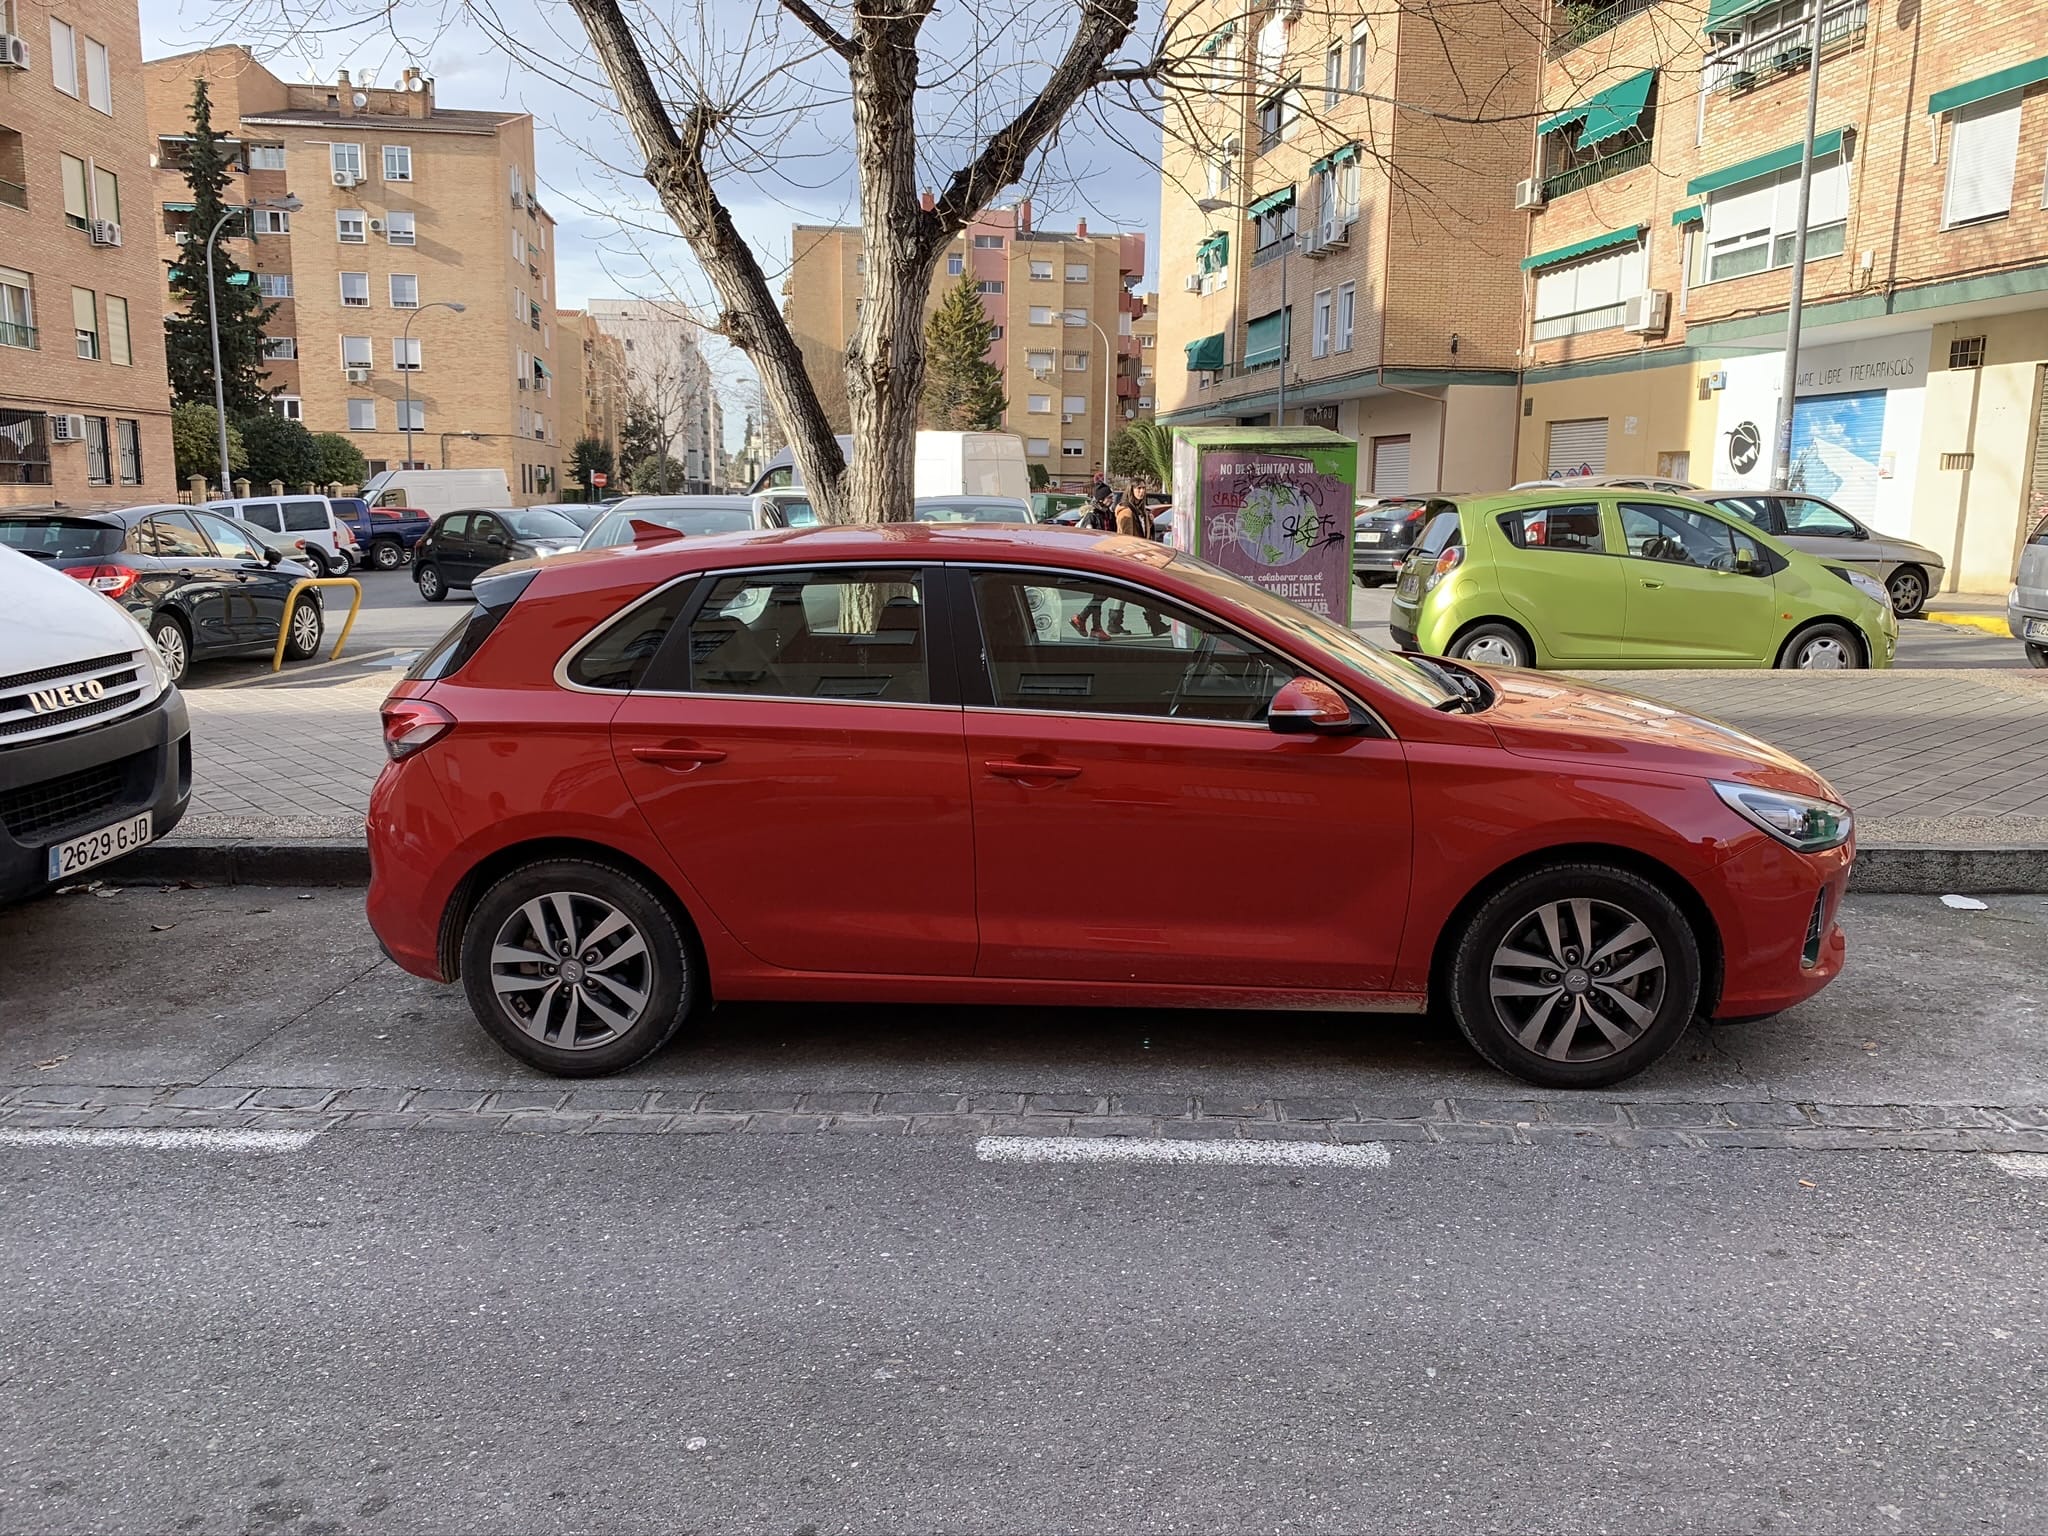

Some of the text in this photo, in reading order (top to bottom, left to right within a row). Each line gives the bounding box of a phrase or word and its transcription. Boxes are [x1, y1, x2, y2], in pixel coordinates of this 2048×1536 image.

[1818, 367, 1842, 386] LIBRE
[1220, 464, 1232, 475] NO
[1298, 462, 1314, 474] SIN
[1258, 572, 1298, 582] colaborar
[1314, 572, 1324, 580] el
[27, 679, 105, 714] IVECO
[62, 816, 148, 872] 2629 GJD
